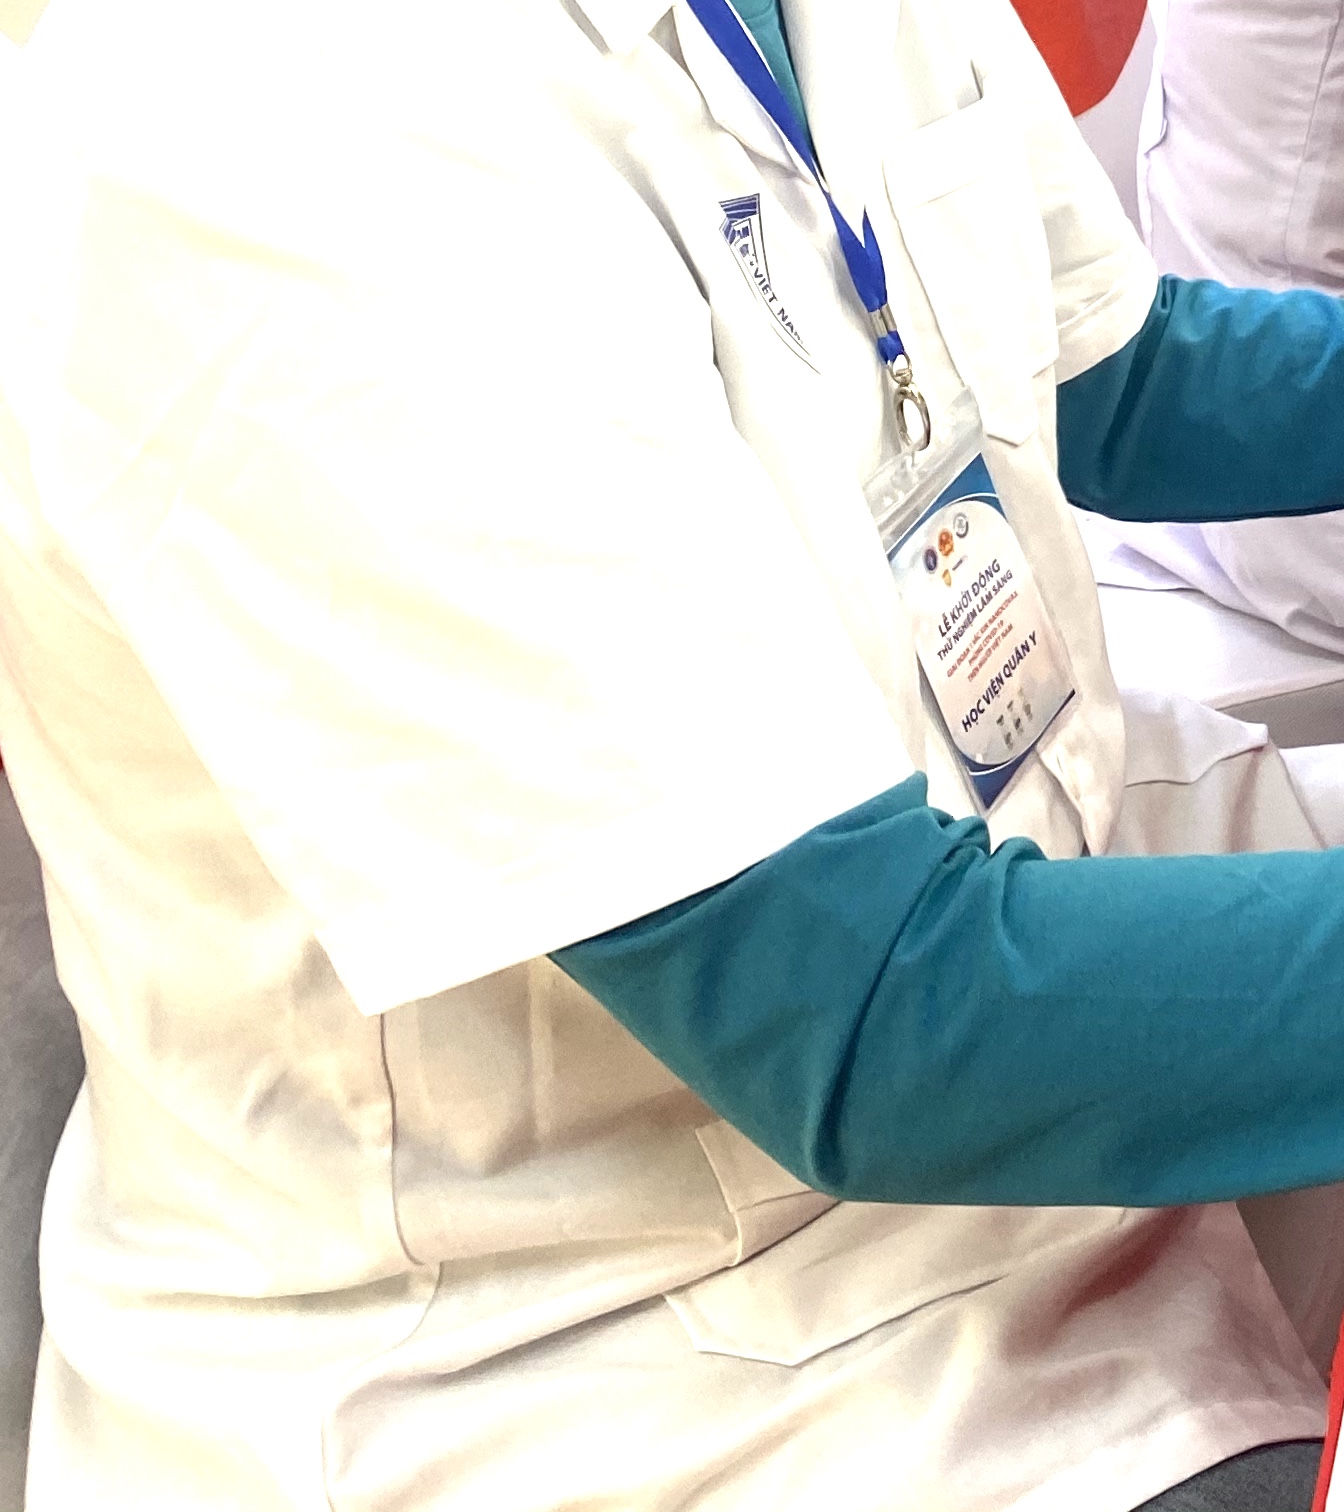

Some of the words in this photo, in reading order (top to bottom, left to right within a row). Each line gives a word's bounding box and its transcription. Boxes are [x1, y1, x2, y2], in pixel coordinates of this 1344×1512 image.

[961, 698, 986, 733] HỌC
[982, 672, 1005, 706] VIỆN
[1028, 629, 1038, 646] Y
